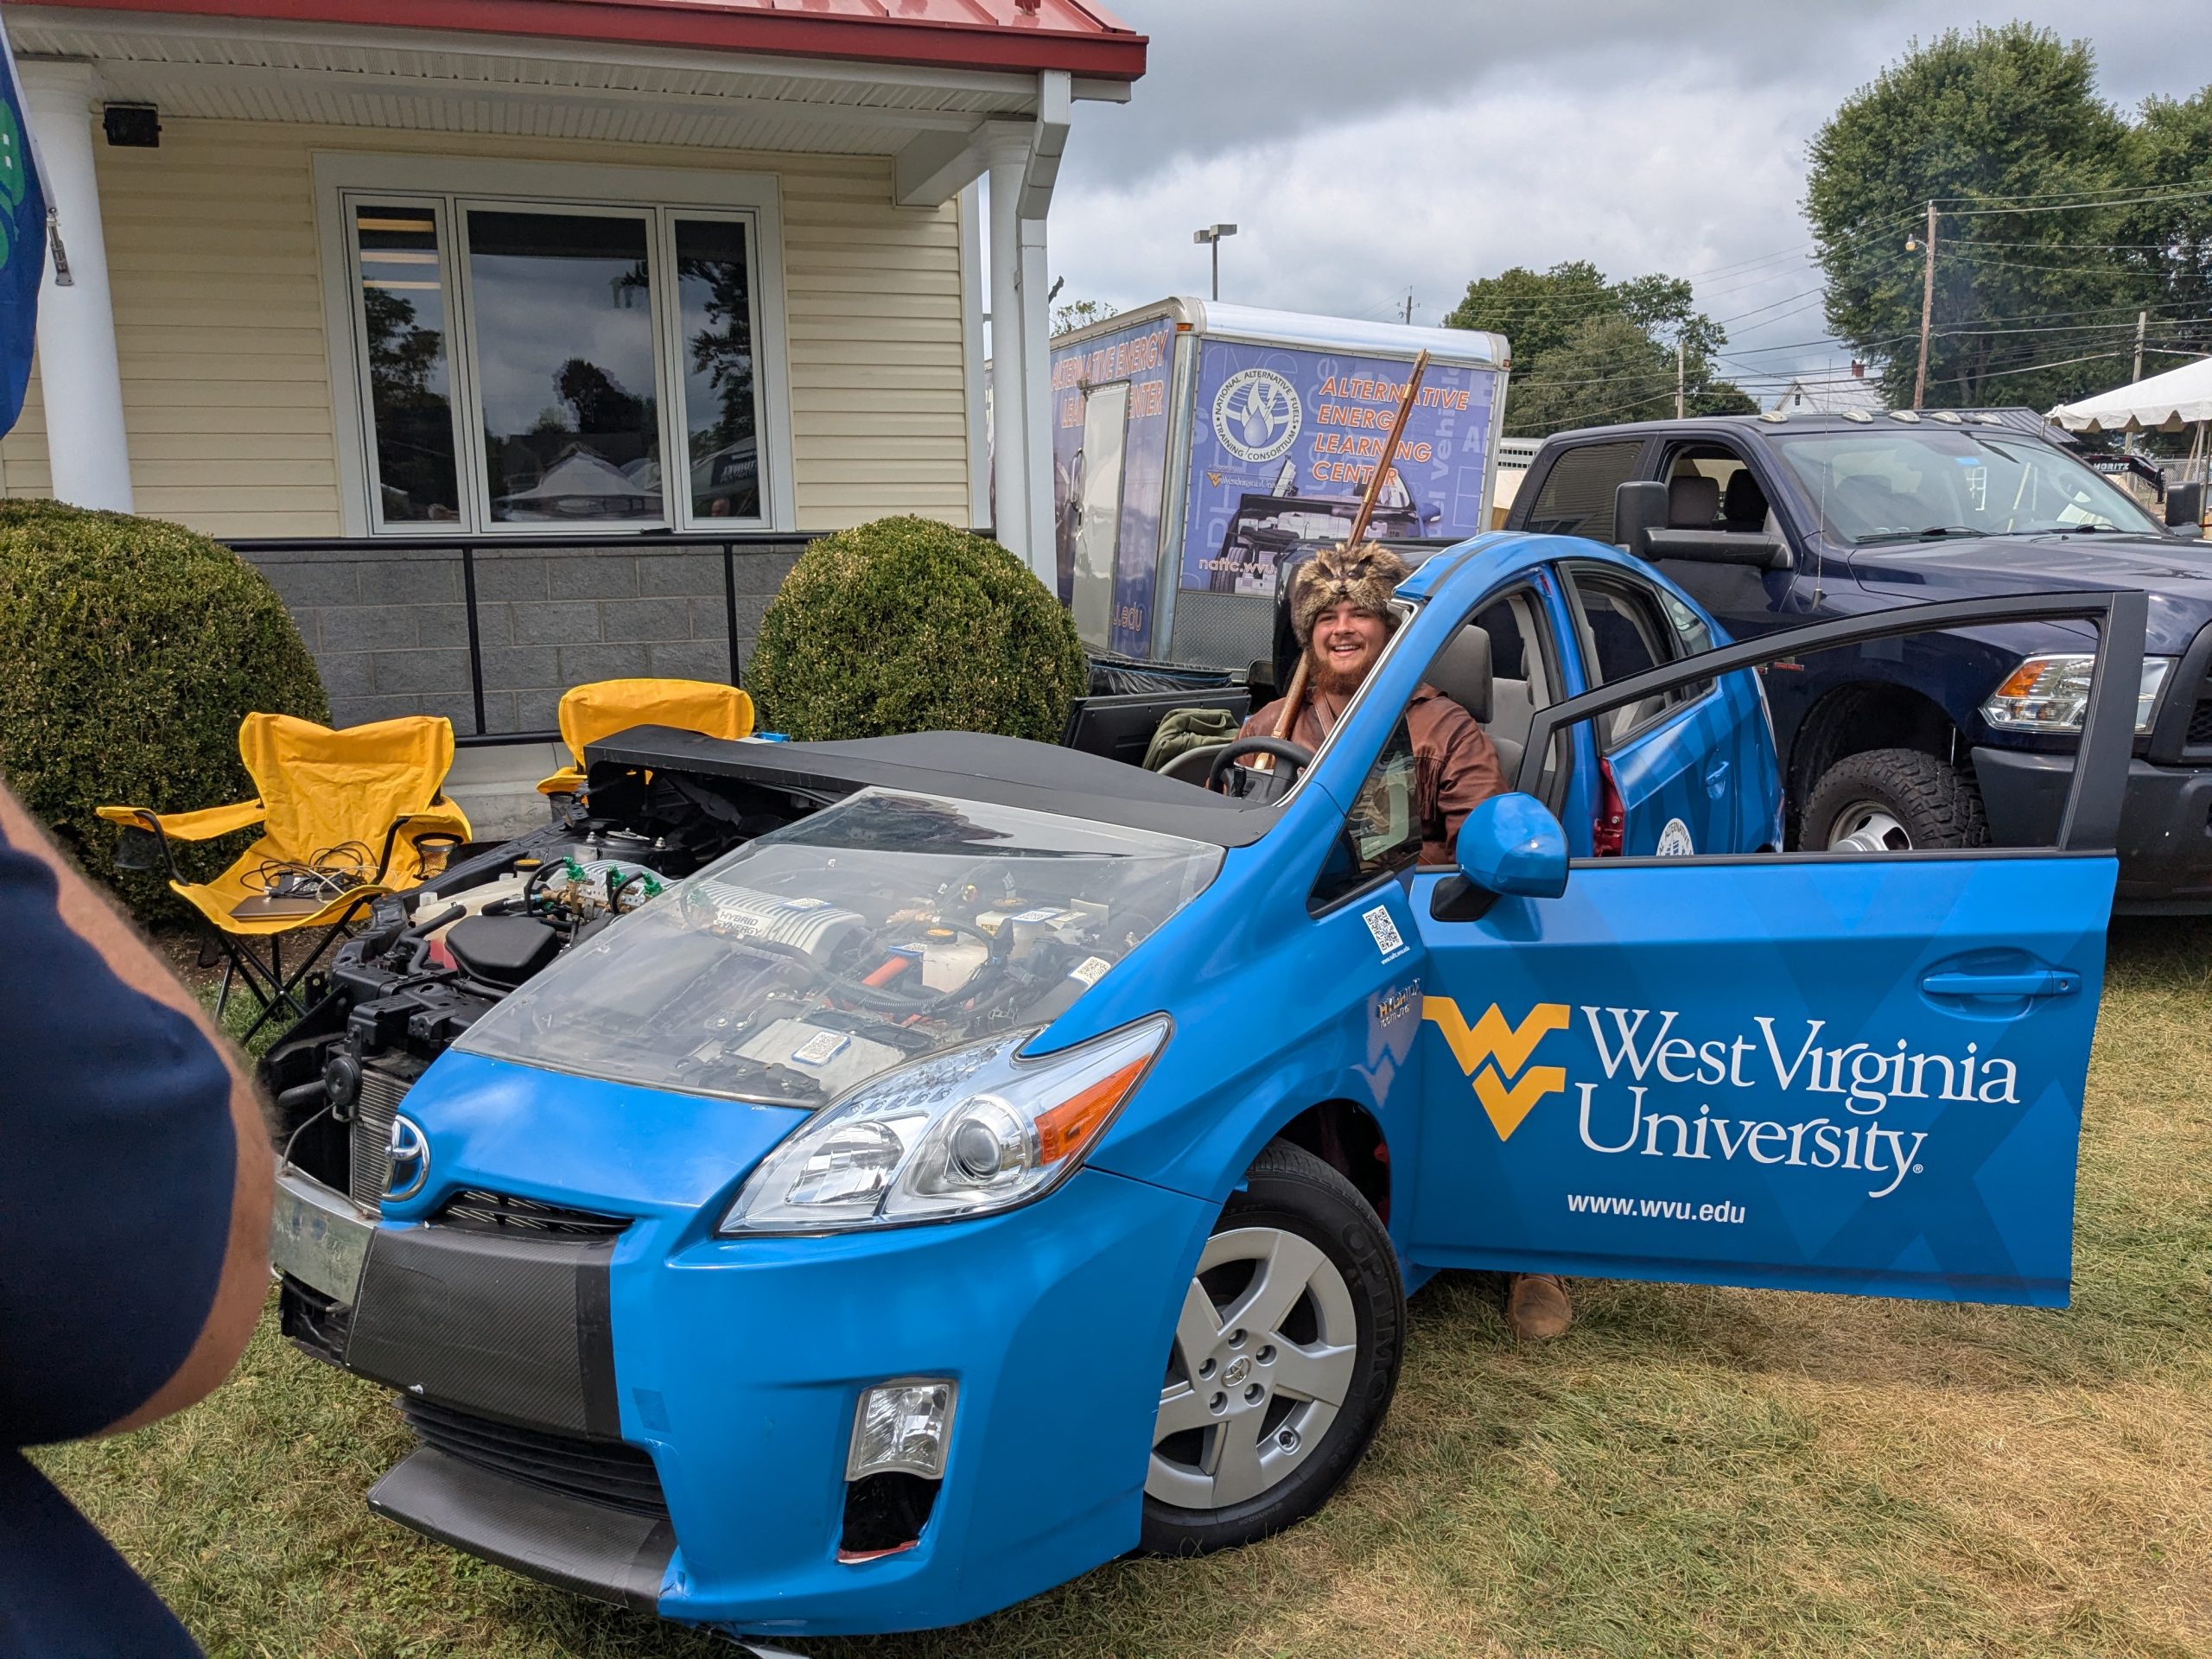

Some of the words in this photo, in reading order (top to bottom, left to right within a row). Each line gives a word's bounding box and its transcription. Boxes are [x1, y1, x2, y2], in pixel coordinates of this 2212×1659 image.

[1051, 346, 1116, 391] ALTERNATIVE
[1116, 329, 1169, 378] ENERGY
[1128, 380, 1164, 420] ENTER
[1215, 377, 1242, 415] NATIONAL
[1244, 370, 1293, 396] ALTERNATIVE
[1290, 397, 1300, 424] FUELS
[1317, 404, 1412, 431] ENERG
[1216, 423, 1244, 457] TRAINING
[1247, 429, 1296, 461] CONSORTIUM
[1314, 433, 1432, 462] LEARNNG
[1313, 461, 1398, 486] CENTR
[2093, 462, 2130, 471] MORITZ
[1198, 557, 1278, 574] naftc.wvu.
[719, 911, 759, 926] HYBRID
[1580, 1005, 1757, 1087] West
[1753, 1016, 2020, 1116] Virginia
[1574, 1082, 1929, 1198] University
[1567, 1193, 1745, 1224] www.wvu.edu
